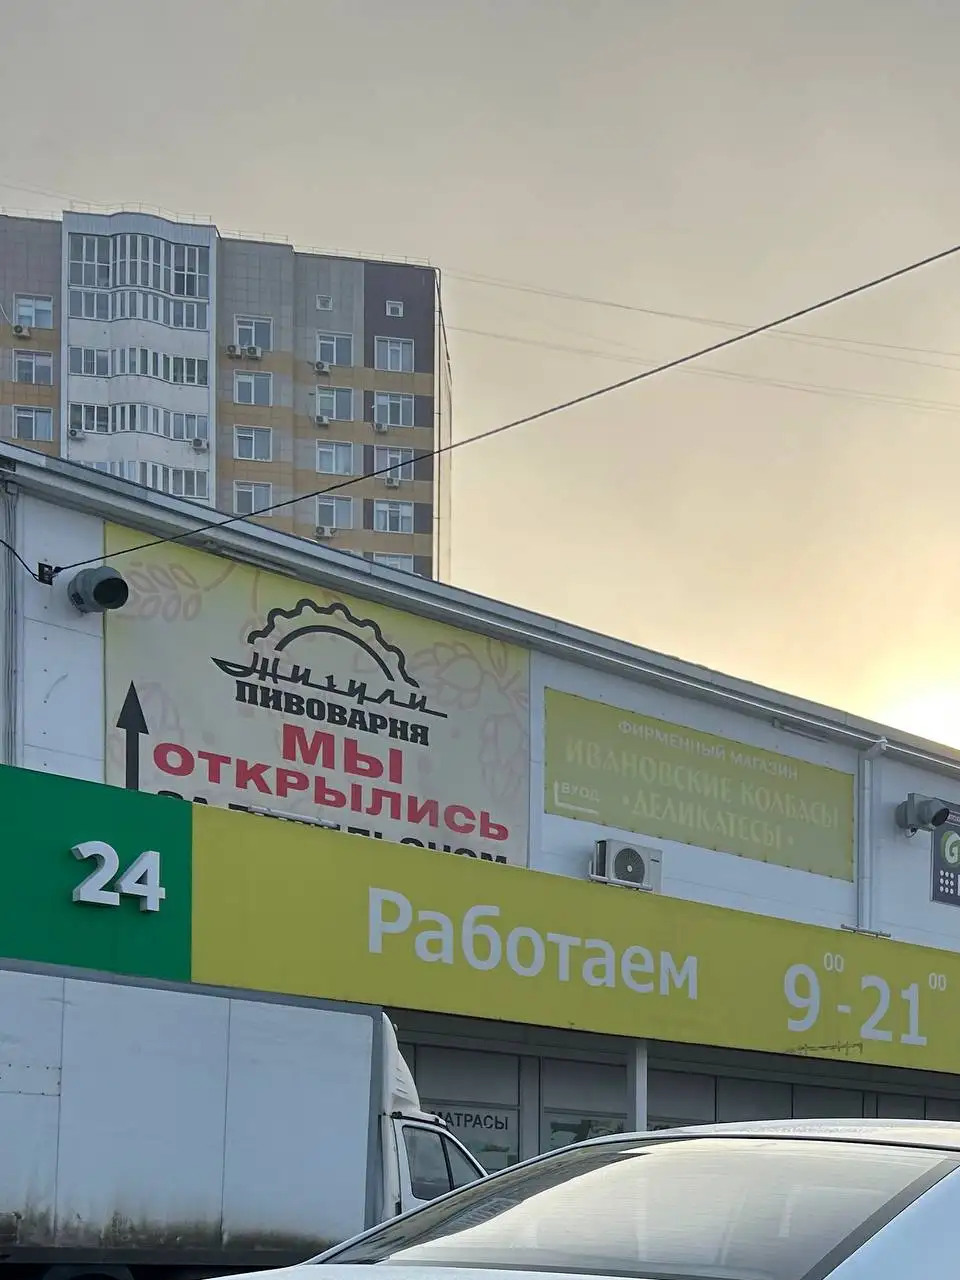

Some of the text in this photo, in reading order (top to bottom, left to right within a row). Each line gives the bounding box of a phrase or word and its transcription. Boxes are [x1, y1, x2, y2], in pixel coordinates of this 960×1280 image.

[234, 680, 430, 746] ПИВОВАРНЯ
[281, 722, 403, 785] МЫ
[564, 733, 840, 829] ИВАНОВСКИЕ КОЛБАСЫ
[617, 719, 799, 781] ФИРМЕННЫЙ МАГАЗИН
[152, 742, 509, 842] ОТКРЫЛИСЬ
[561, 781, 601, 804] ВХОД
[70, 840, 166, 912] 24
[368, 887, 699, 1000] Работаем
